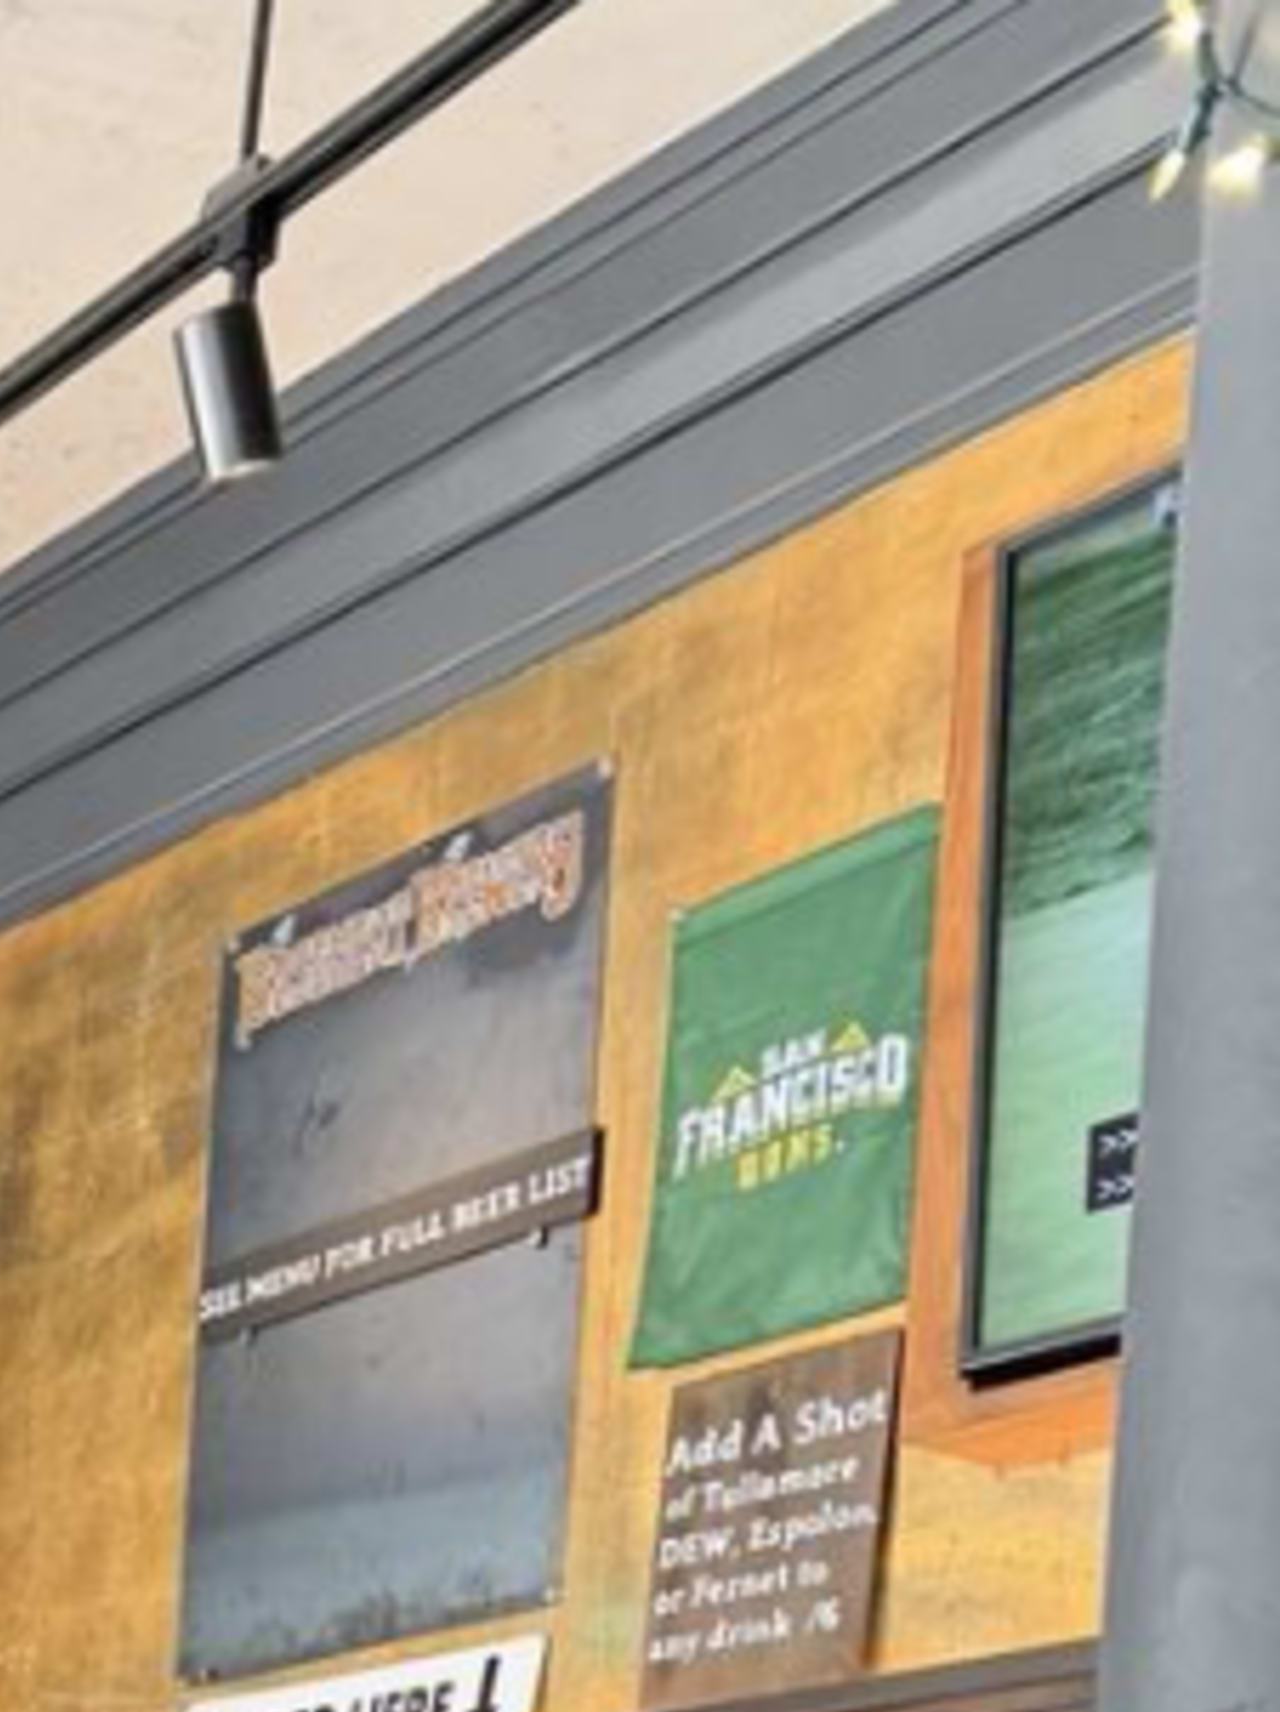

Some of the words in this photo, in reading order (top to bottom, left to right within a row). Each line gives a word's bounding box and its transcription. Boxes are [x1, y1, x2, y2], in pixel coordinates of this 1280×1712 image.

[760, 1027, 827, 1079] SAN
[671, 1032, 909, 1184] FRANCISCO
[198, 1281, 243, 1321] SEE
[244, 1254, 322, 1306] MENU
[324, 1235, 375, 1281] FOR
[379, 1211, 445, 1258] FULL
[449, 1182, 523, 1232] BEER
[527, 1153, 592, 1201] LIST
[667, 1419, 744, 1477] Add
[750, 1412, 782, 1455] A
[792, 1387, 888, 1446] Shot
[663, 1484, 697, 1522] of
[702, 1456, 861, 1512] Tullamore
[652, 1587, 687, 1618] or
[689, 1561, 789, 1608] Fernet
[796, 1560, 829, 1588] to
[647, 1630, 702, 1666] any
[705, 1603, 791, 1650] drink
